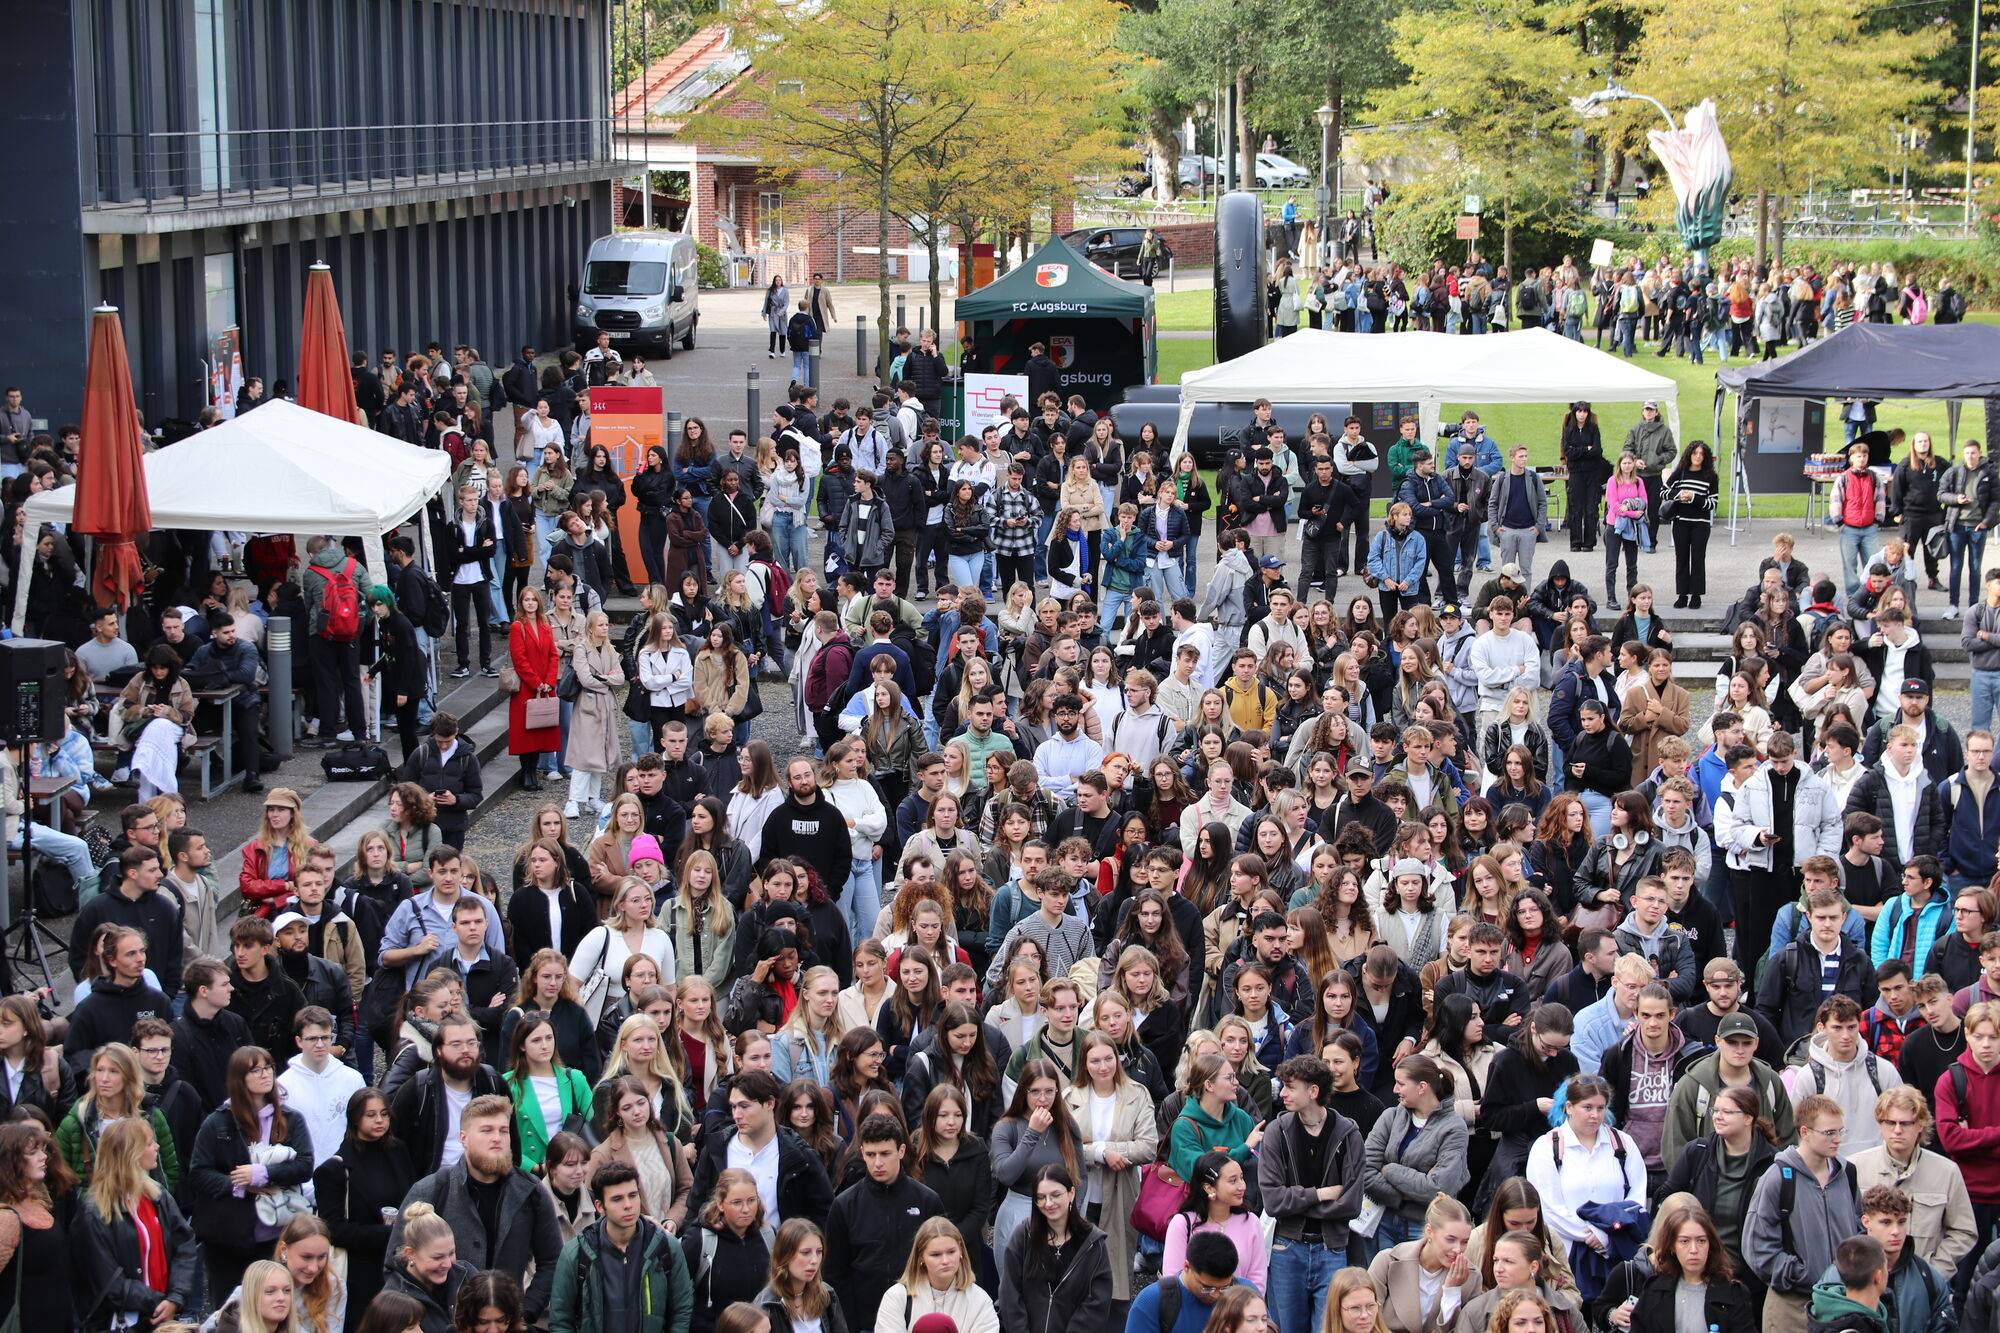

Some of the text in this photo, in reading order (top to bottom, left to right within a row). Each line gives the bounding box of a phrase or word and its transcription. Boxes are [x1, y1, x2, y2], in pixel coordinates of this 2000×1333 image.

[1012, 301, 1088, 313] FC Augsburg
[1060, 372, 1112, 386] gsburg
[938, 418, 961, 428] BURG
[791, 819, 820, 832] IDENTITY
